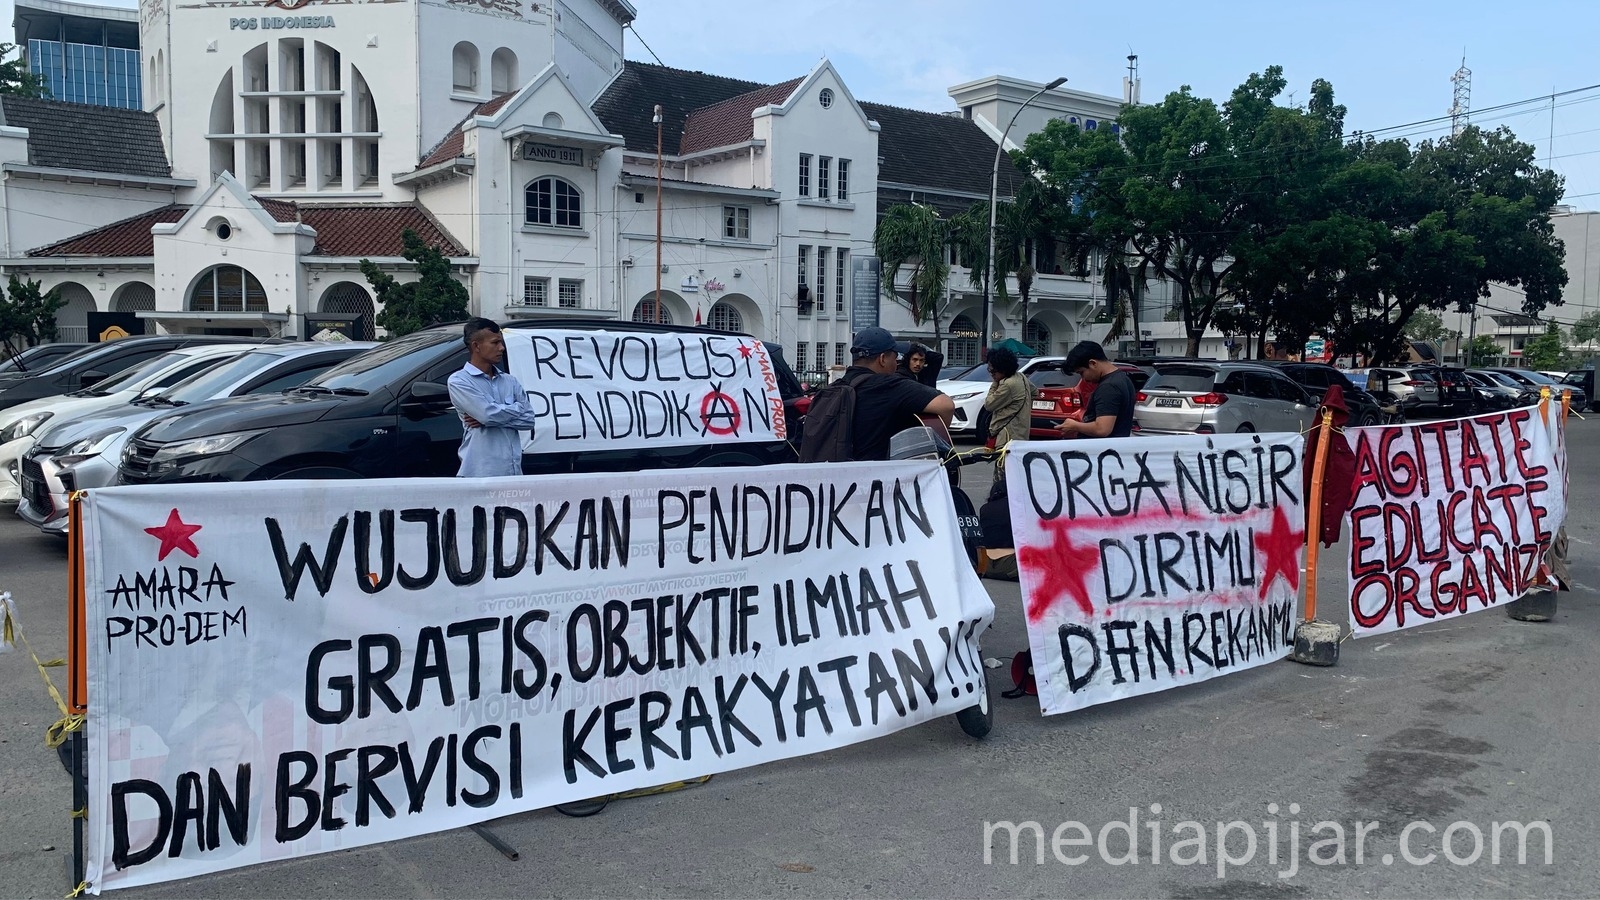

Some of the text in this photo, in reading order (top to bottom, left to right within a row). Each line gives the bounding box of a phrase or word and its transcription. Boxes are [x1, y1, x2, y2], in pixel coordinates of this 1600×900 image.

[229, 15, 336, 31] POS INDONESIA
[528, 147, 576, 162] ANNO 1911
[531, 336, 753, 381] REVOLUSI
[526, 382, 771, 440] PENDIDIKAN
[1022, 434, 1299, 520] ORGANISIR
[1347, 410, 1548, 510] AGITATE
[264, 476, 934, 602] WUJUDKAN PENDIDIKAN
[1098, 526, 1256, 605] DIRIMU
[1351, 481, 1552, 580] EDUCATE
[106, 562, 236, 612] AMARA
[106, 605, 248, 654] PRO-DEM
[305, 606, 563, 725] GRATIS,
[566, 586, 761, 684] OBJEKTIF,
[773, 558, 938, 647] ILMIAH
[1058, 612, 1176, 694] DAN
[110, 761, 252, 872] DAN
[274, 722, 523, 844] BERVISI
